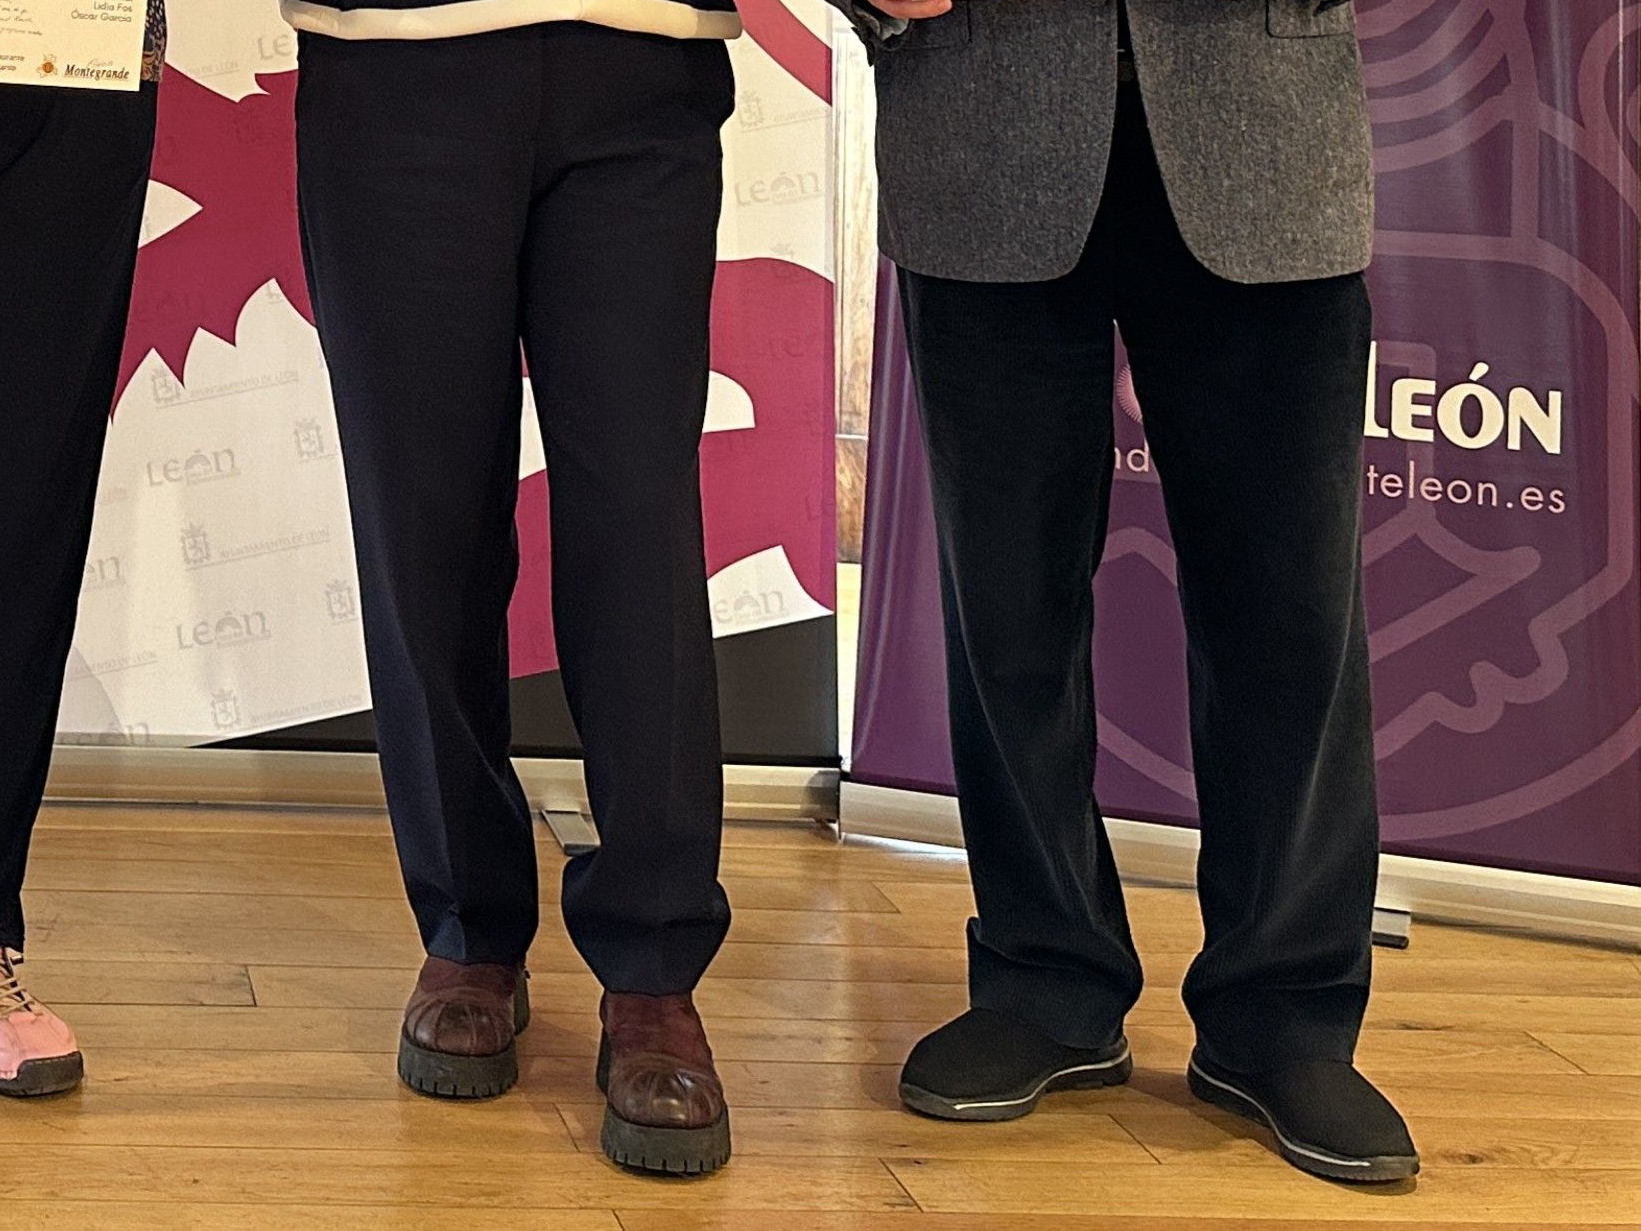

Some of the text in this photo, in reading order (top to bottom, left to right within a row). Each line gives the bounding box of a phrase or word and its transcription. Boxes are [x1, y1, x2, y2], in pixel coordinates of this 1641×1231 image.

[64, 64, 130, 81] Montegrande
[1363, 340, 1562, 455] LEÓN
[1367, 459, 1566, 514] teleon.es
